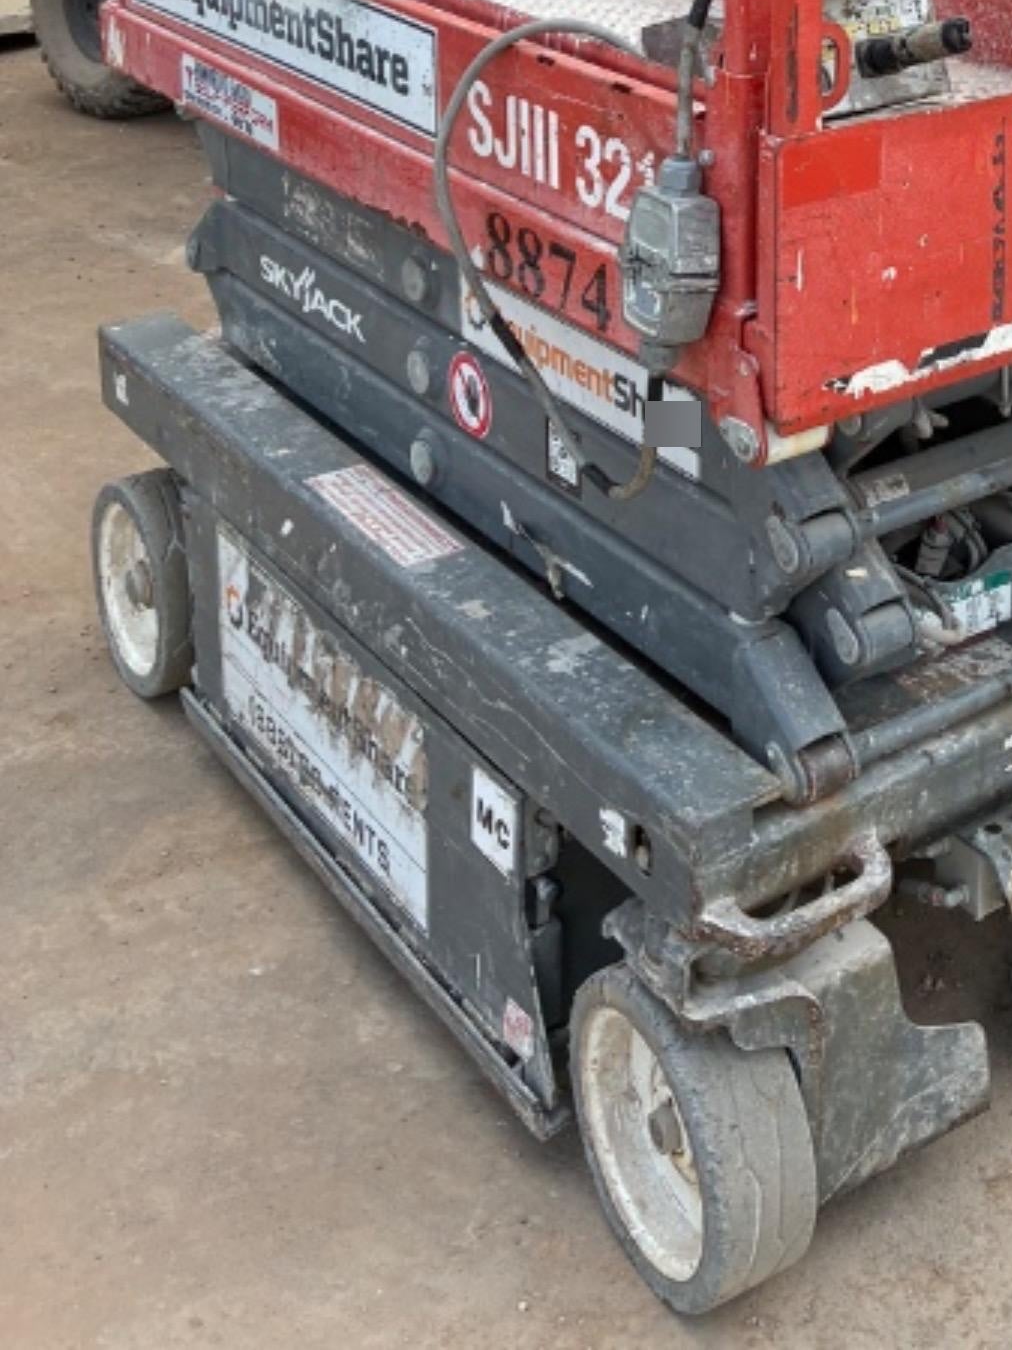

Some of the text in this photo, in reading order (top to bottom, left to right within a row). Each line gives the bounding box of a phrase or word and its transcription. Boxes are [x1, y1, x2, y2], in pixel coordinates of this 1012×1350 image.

[467, 80, 559, 190] SJIII
[260, 254, 366, 342] SKYJACK
[486, 212, 612, 331] 8874
[476, 796, 510, 850] MC
